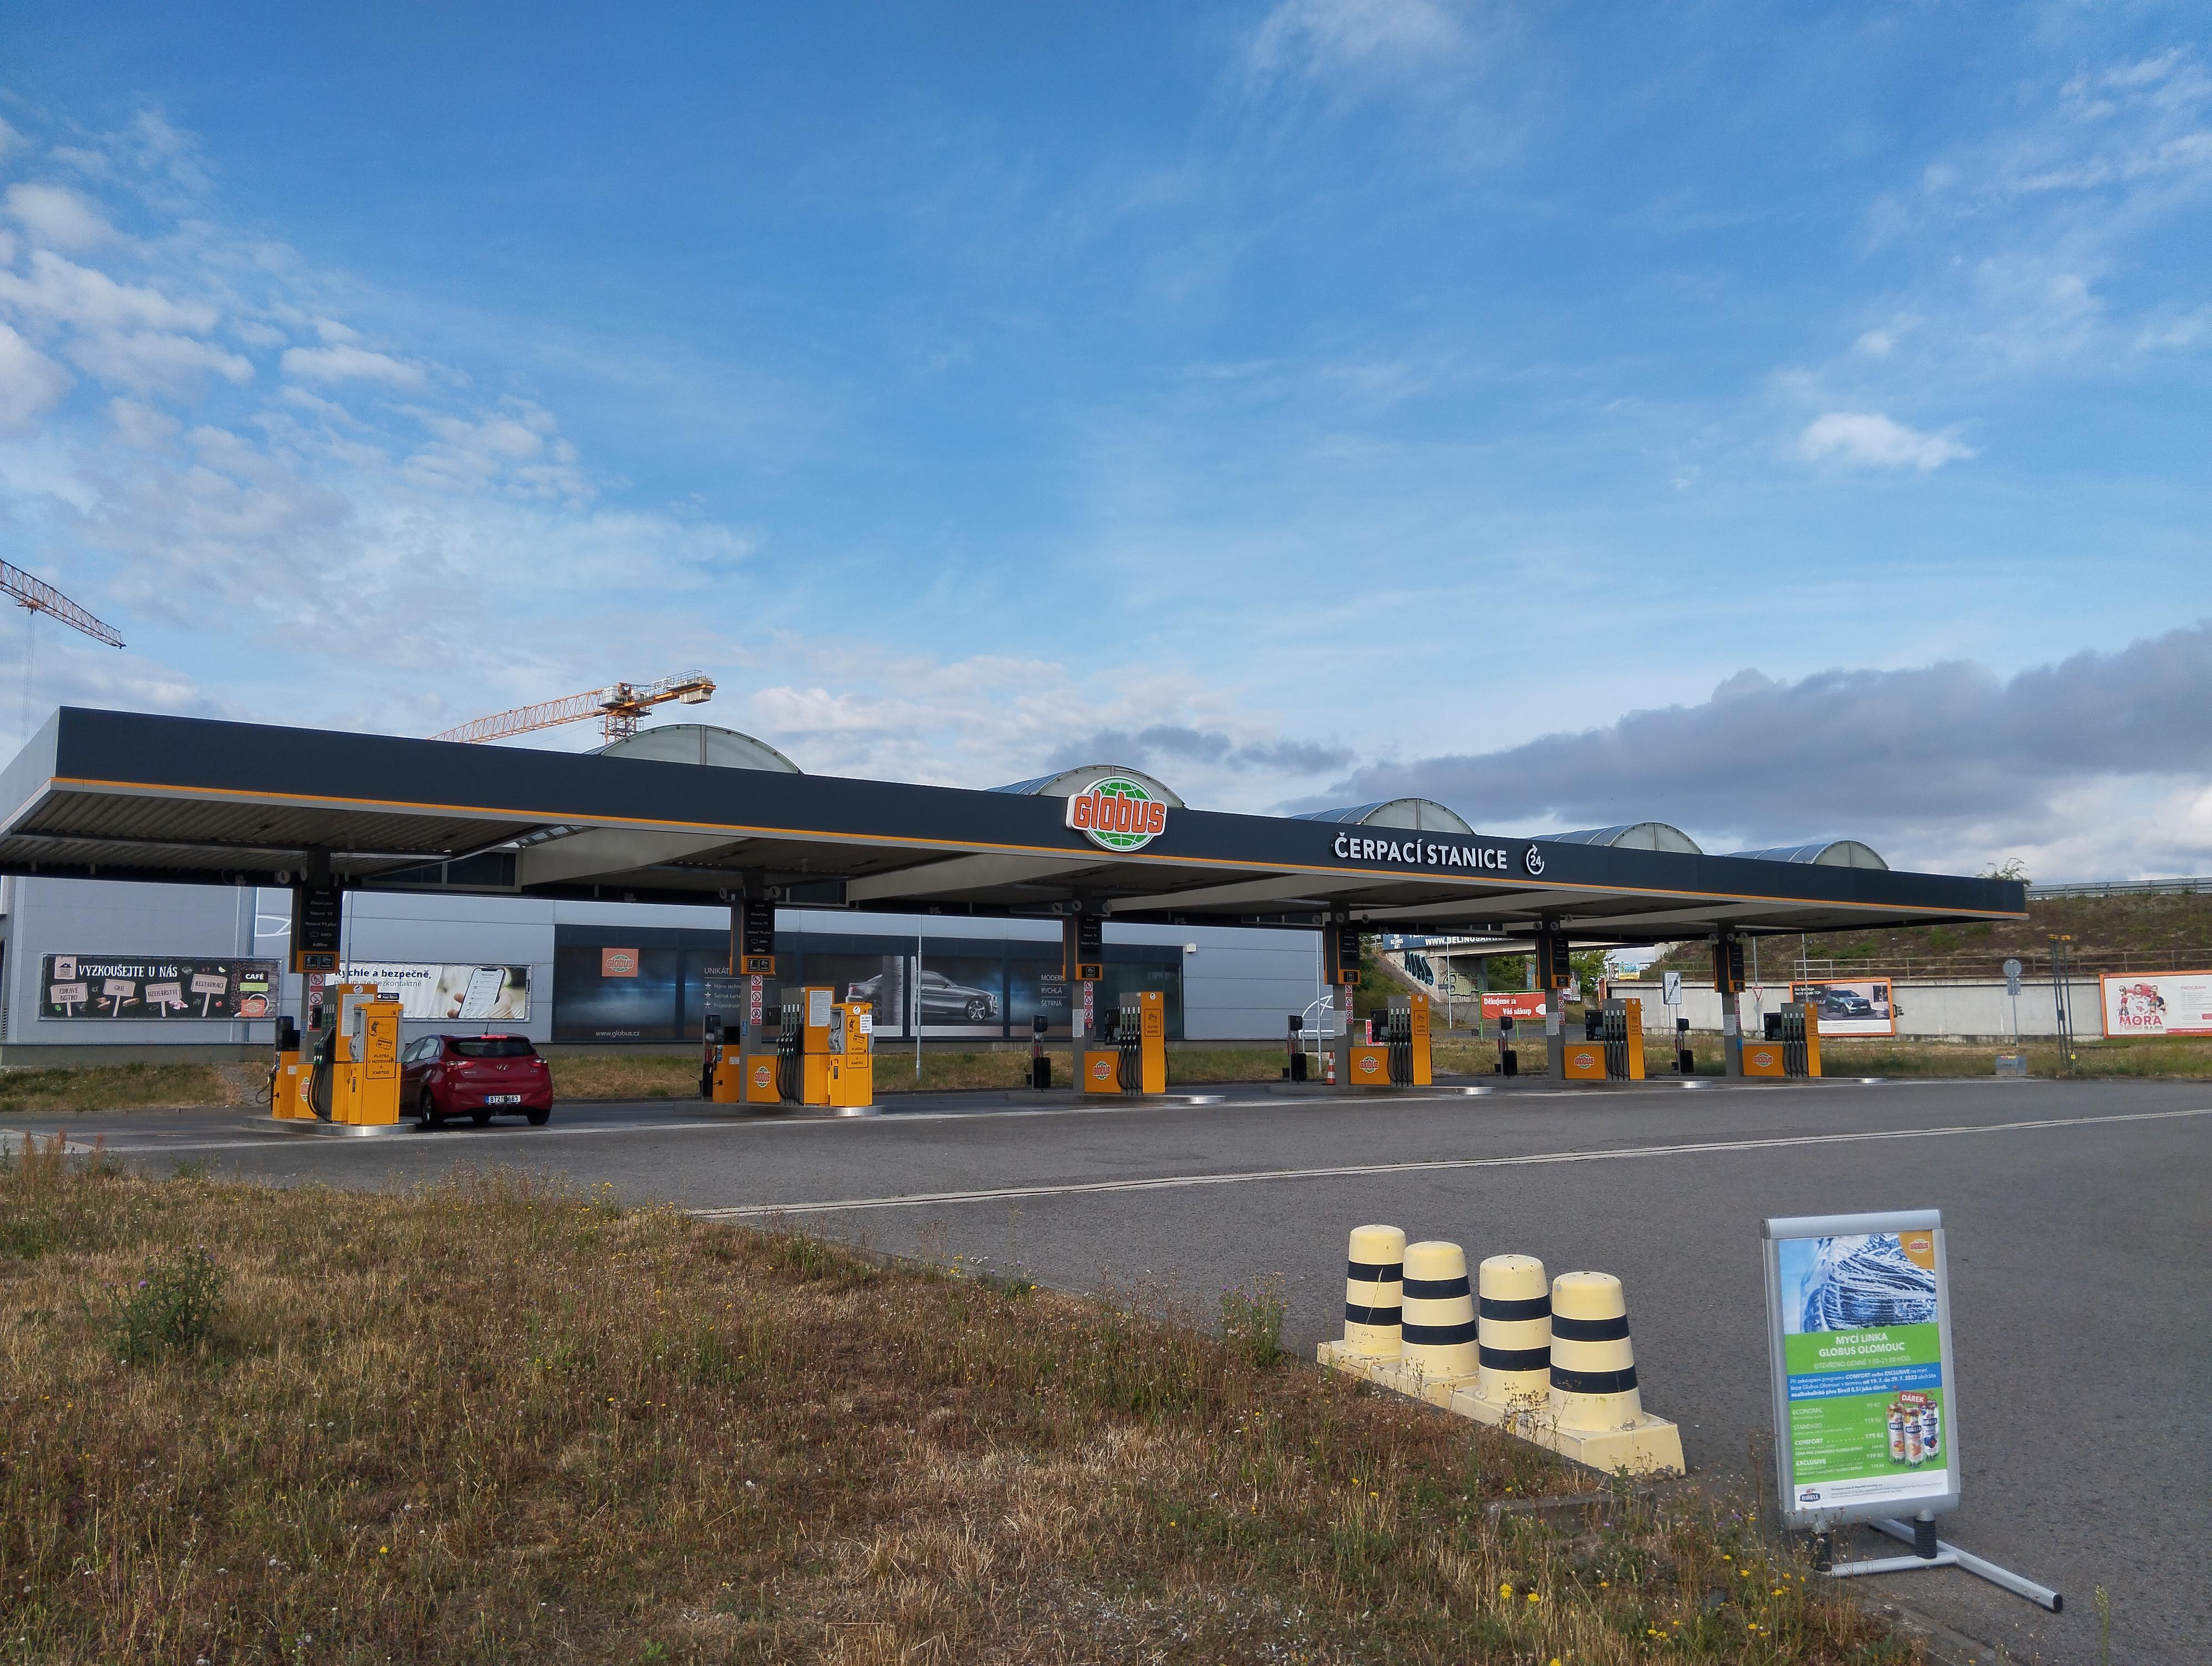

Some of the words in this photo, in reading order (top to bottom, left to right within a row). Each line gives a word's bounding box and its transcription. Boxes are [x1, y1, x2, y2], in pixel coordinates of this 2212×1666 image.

[1074, 790, 1165, 833] Globus
[1334, 832, 1422, 863] ČERPACÍ
[1427, 844, 1507, 869] STANICE
[1530, 855, 1542, 867] 24
[607, 957, 634, 967] Globus
[79, 964, 144, 977] VYZKOUŠEJTE
[148, 966, 155, 977] U
[159, 965, 178, 977] NÁS
[381, 969, 431, 980] bezpečně,
[148, 988, 178, 997] UZENÁŘSTVÍ
[1484, 997, 1510, 1006] Děkujeme
[1514, 1007, 1531, 1016] nákup
[2119, 1015, 2163, 1026] MORA
[1836, 1333, 1859, 1344] MYCÍ
[1861, 1332, 1888, 1342] LINKA
[1819, 1346, 1856, 1357] GLOBUS
[1858, 1342, 1905, 1354] OLOMOUC
[1791, 1389, 1826, 1397] nealkoholické
[1901, 1393, 1924, 1403] DÁREK
